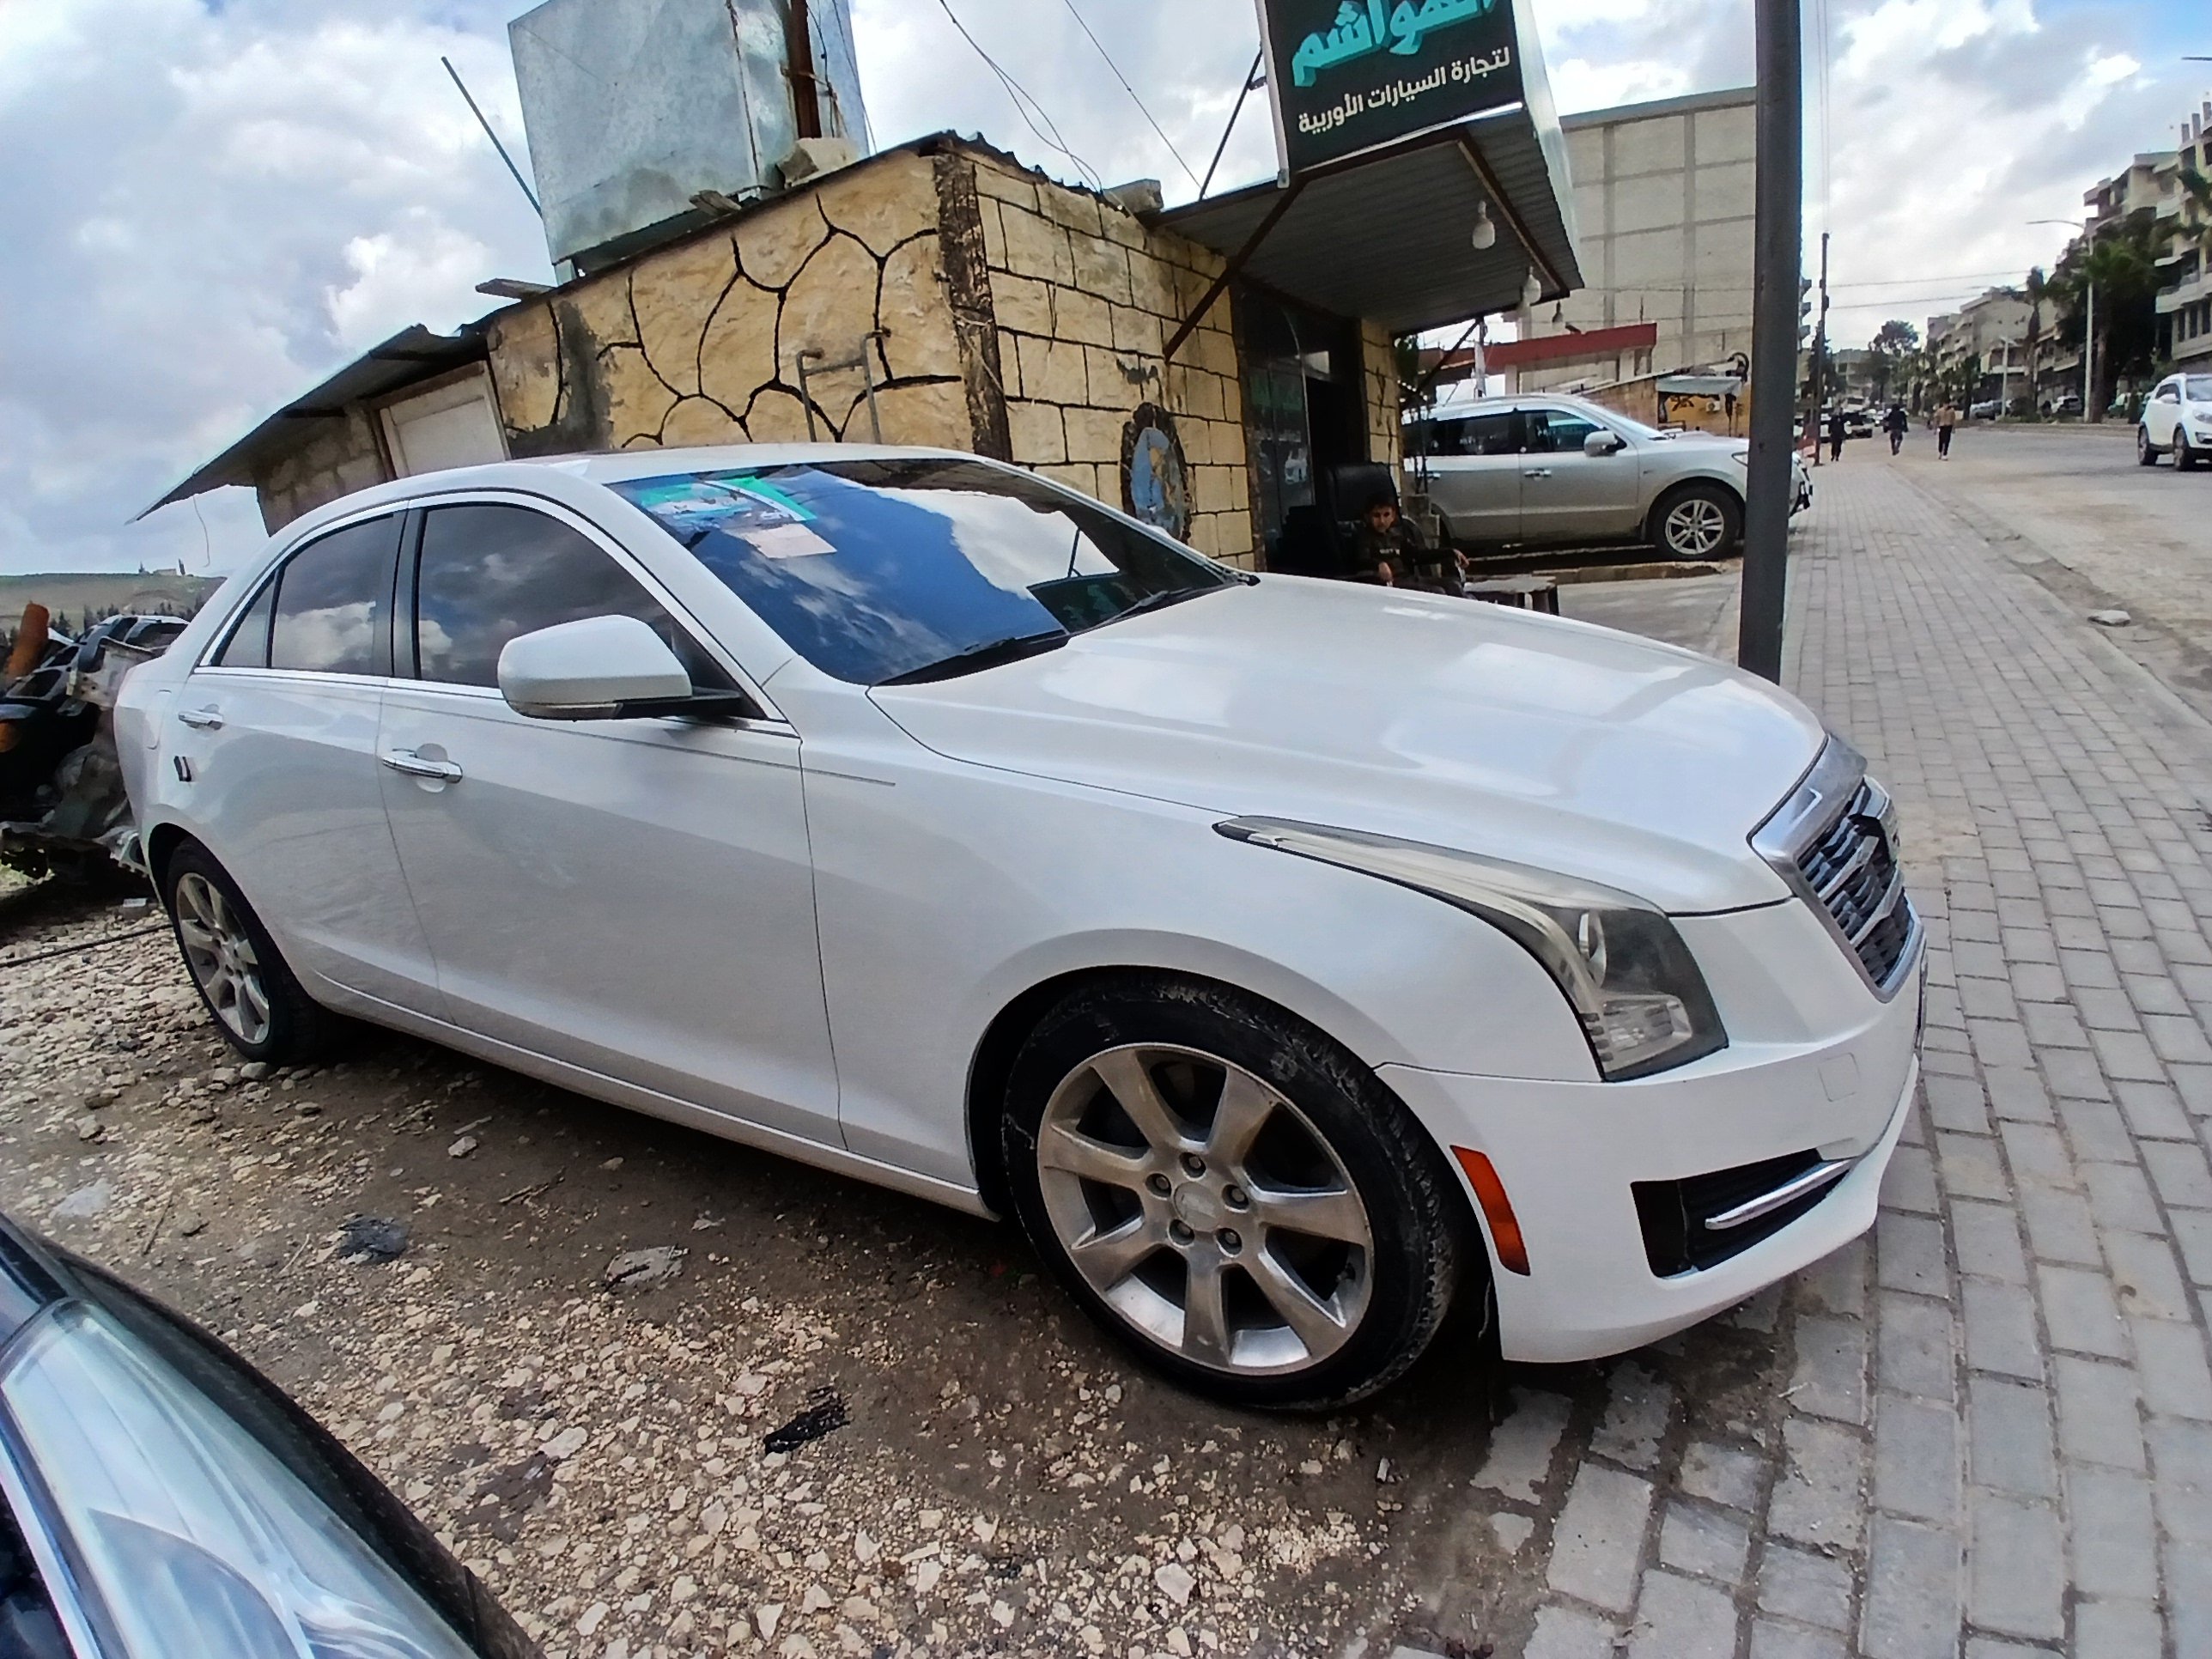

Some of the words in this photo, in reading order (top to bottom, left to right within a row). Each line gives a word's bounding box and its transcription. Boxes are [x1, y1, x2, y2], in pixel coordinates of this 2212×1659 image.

[1451, 46, 1510, 84] لتجارة
[1367, 66, 1447, 108] السيارات
[1297, 93, 1364, 135] الأوربية
